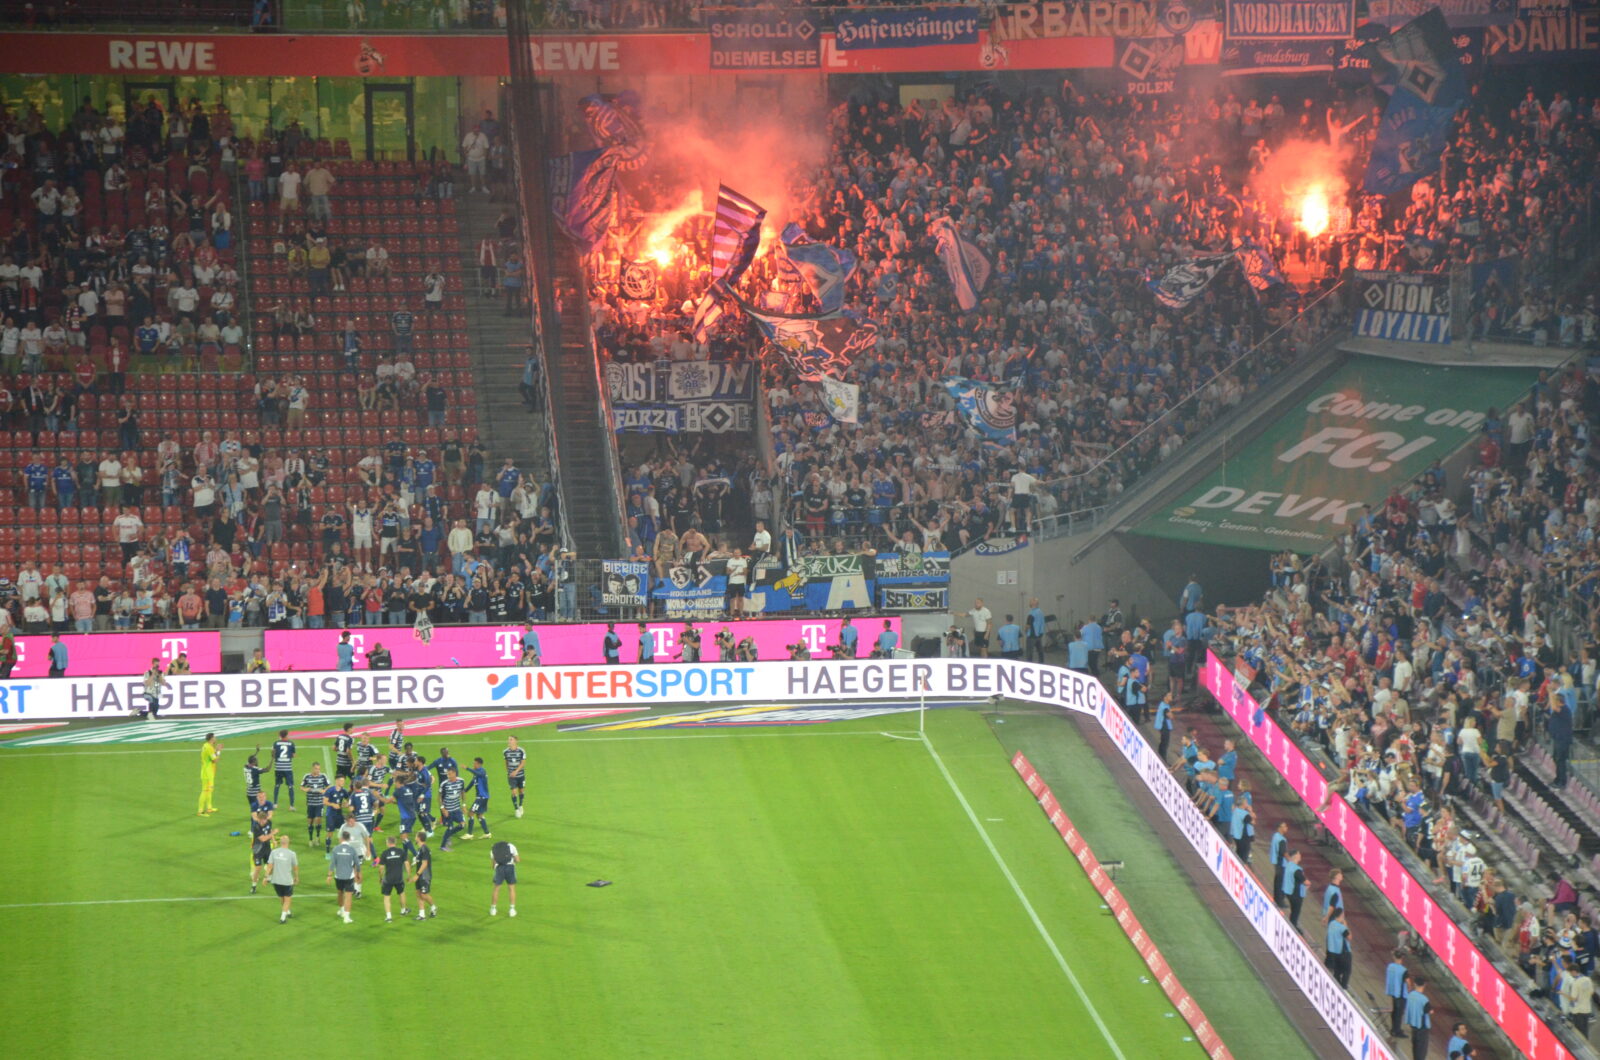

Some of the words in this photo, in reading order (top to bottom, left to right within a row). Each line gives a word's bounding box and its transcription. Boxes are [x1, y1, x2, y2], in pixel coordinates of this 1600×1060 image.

[836, 16, 978, 45] Hafensänger
[1232, 2, 1348, 33] NORDHAUSEN
[109, 41, 216, 70] REWE
[712, 51, 817, 66] DIEMELSEE
[1128, 81, 1175, 94] POLEN
[1384, 282, 1434, 313] IRON
[1358, 309, 1450, 343] LOYALTY
[614, 409, 679, 431] FARZA
[1306, 392, 1425, 421] Come
[1277, 427, 1437, 473] FC!
[1189, 486, 1364, 525] DEVK
[602, 594, 647, 605] BANDITEN
[71, 680, 225, 712] HAEGER
[241, 674, 445, 707] BENSBERG
[525, 668, 755, 700] INTERSPORT
[787, 664, 933, 695] HAEGER
[946, 664, 1097, 711] BENSBERG
[1105, 698, 1144, 770] INTERSPORT
[280, 745, 288, 758] 2
[360, 795, 369, 809] 3
[1221, 850, 1269, 936] INTERSPORT
[1274, 914, 1306, 988] HAEGER
[1308, 958, 1354, 1047] BENSBERG
